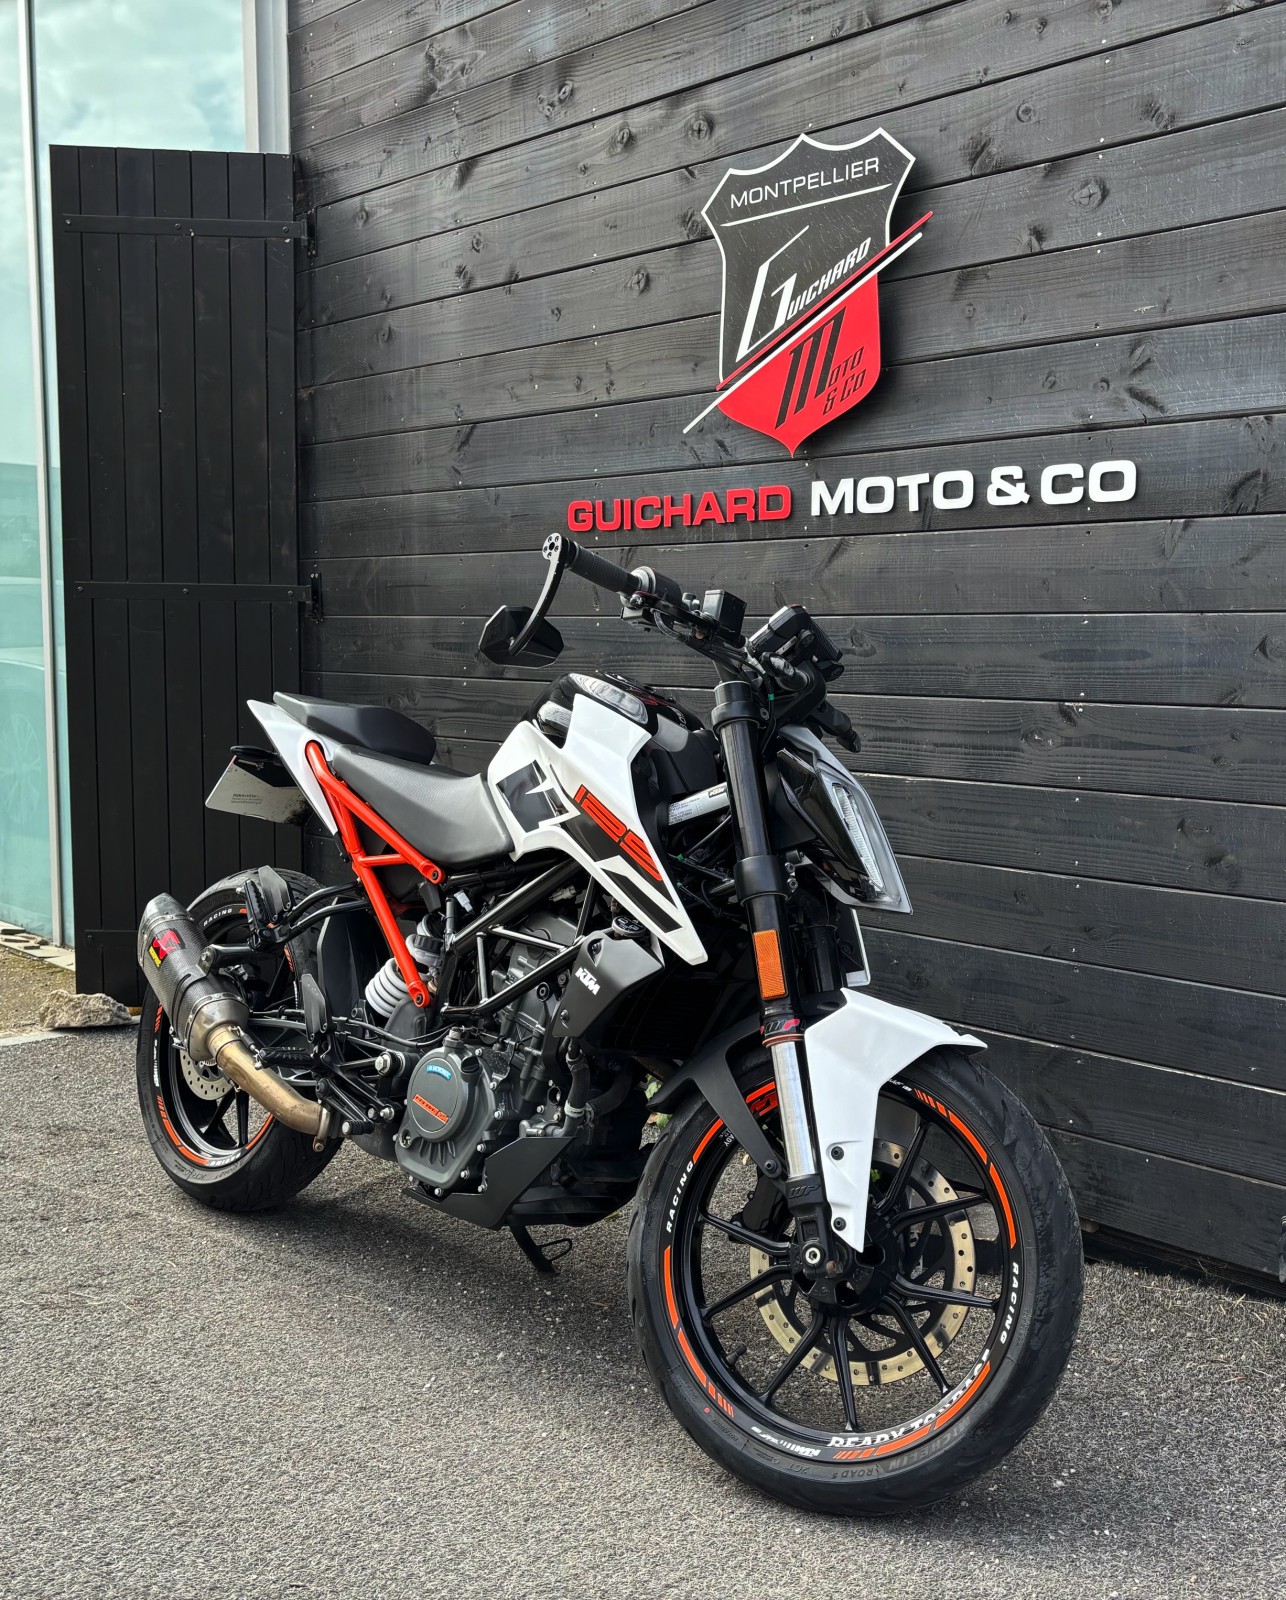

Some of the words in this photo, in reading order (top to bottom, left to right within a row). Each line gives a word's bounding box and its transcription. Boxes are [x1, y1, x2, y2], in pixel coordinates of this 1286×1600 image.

[729, 156, 880, 209] MONTPELLIER
[567, 484, 793, 533] GUICHARD
[810, 469, 975, 517] MOTO
[986, 465, 1031, 506] &
[1040, 459, 1138, 505] CO
[573, 784, 663, 882] 125
[203, 908, 232, 927] RACING
[574, 966, 601, 996] KTM
[665, 1160, 694, 1233] RACING
[999, 1261, 1019, 1345] RACING
[841, 1465, 875, 1479] ROAD
